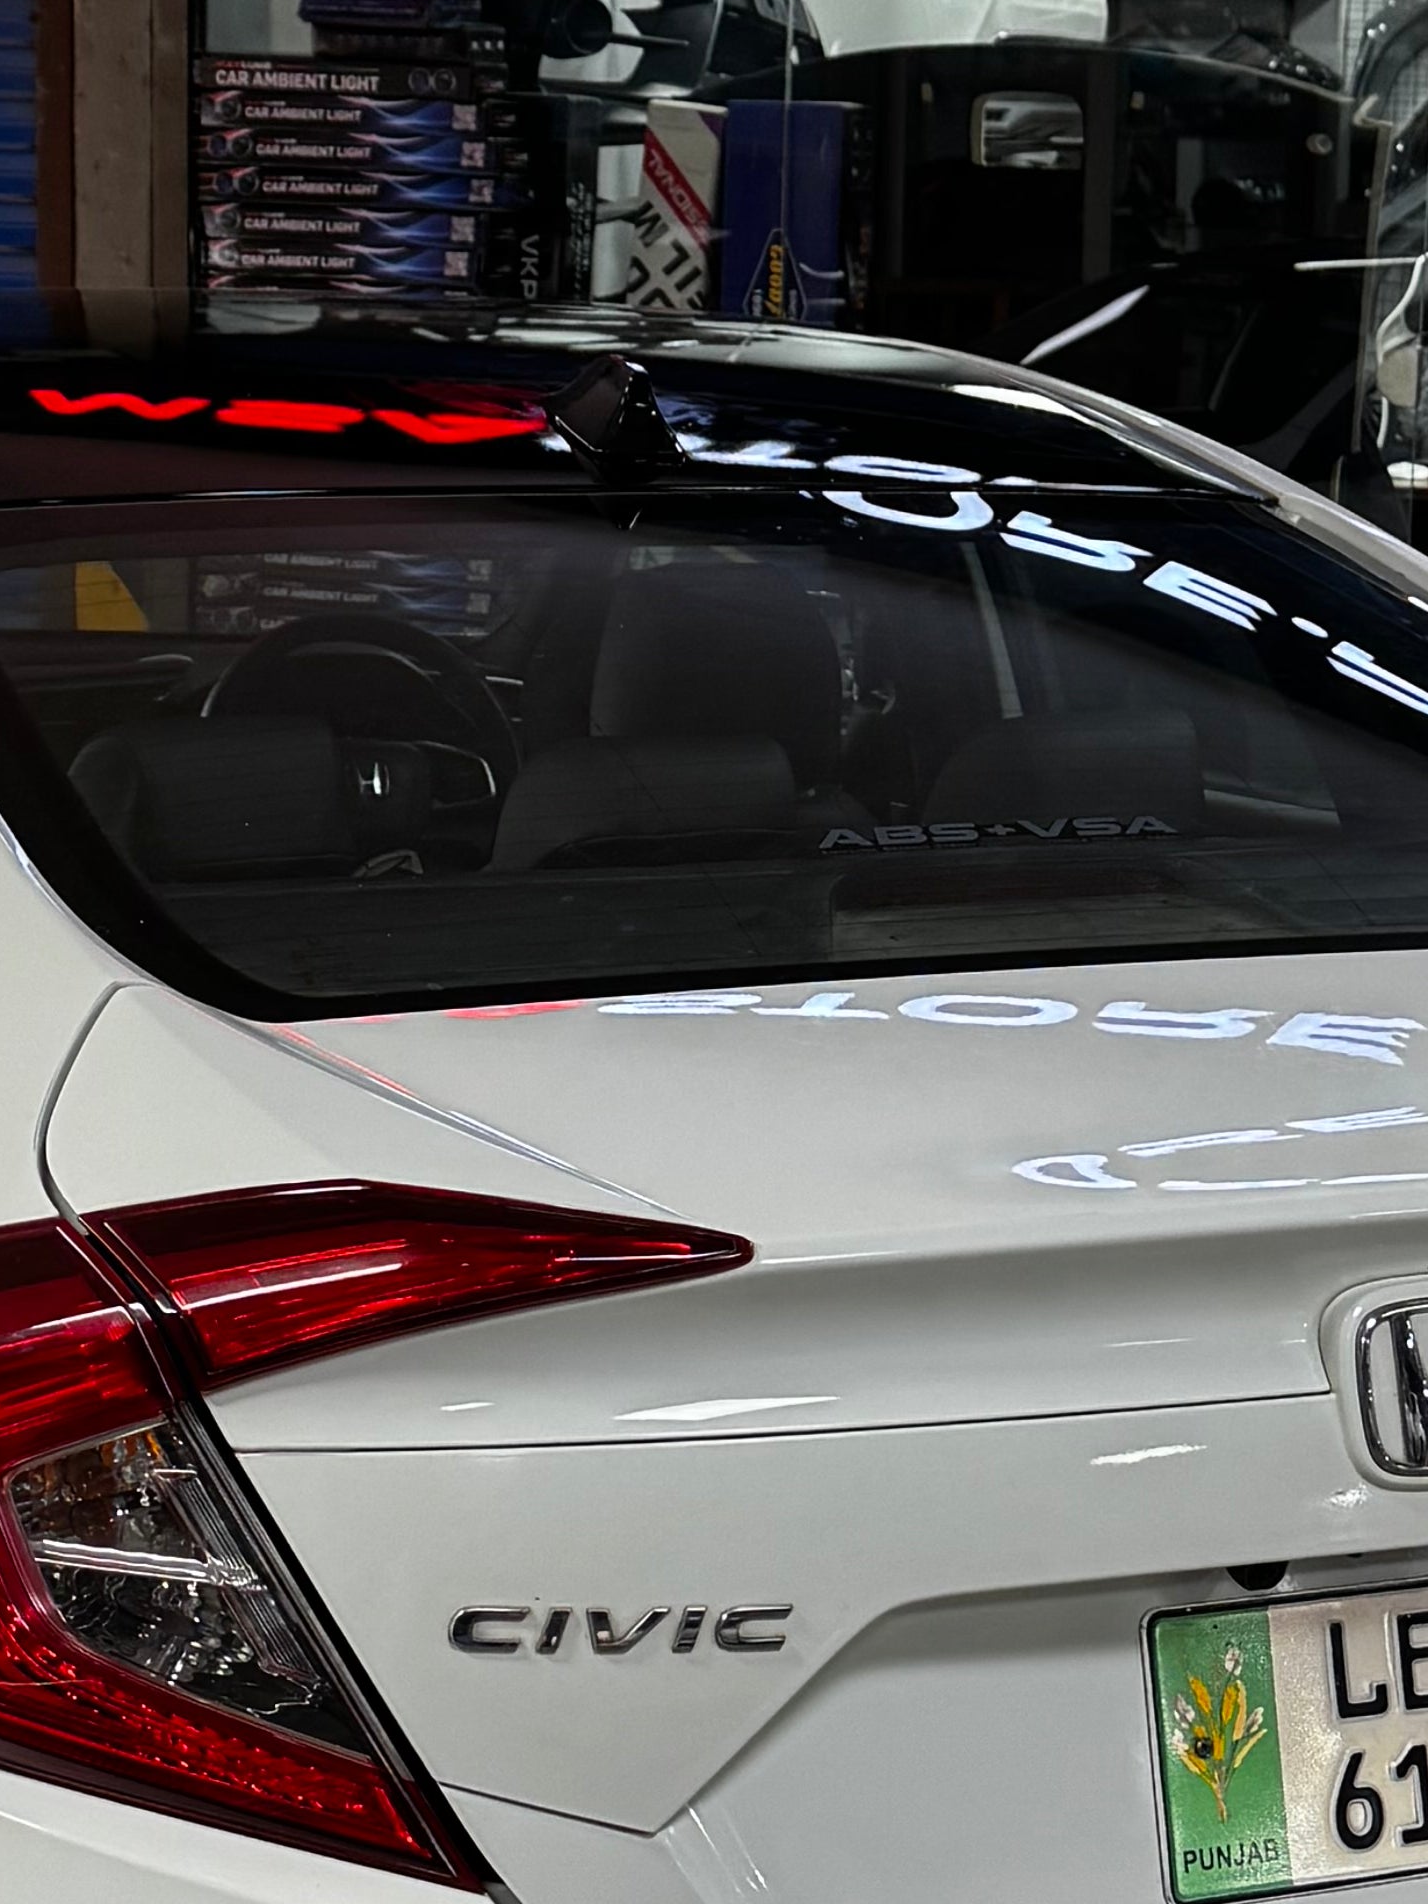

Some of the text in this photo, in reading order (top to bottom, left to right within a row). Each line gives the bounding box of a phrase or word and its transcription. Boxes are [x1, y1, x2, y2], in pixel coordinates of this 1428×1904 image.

[215, 69, 380, 92] CAR AMBIENT LIGHT
[244, 105, 361, 123] CAR AMBIENT LIGHT
[255, 142, 281, 157] CAR
[262, 181, 288, 194] CAR
[244, 218, 270, 231] CAR
[818, 814, 1179, 851] ABS+VSA
[447, 1604, 793, 1656] CIVIC
[1182, 1839, 1281, 1876] PUNJAB
